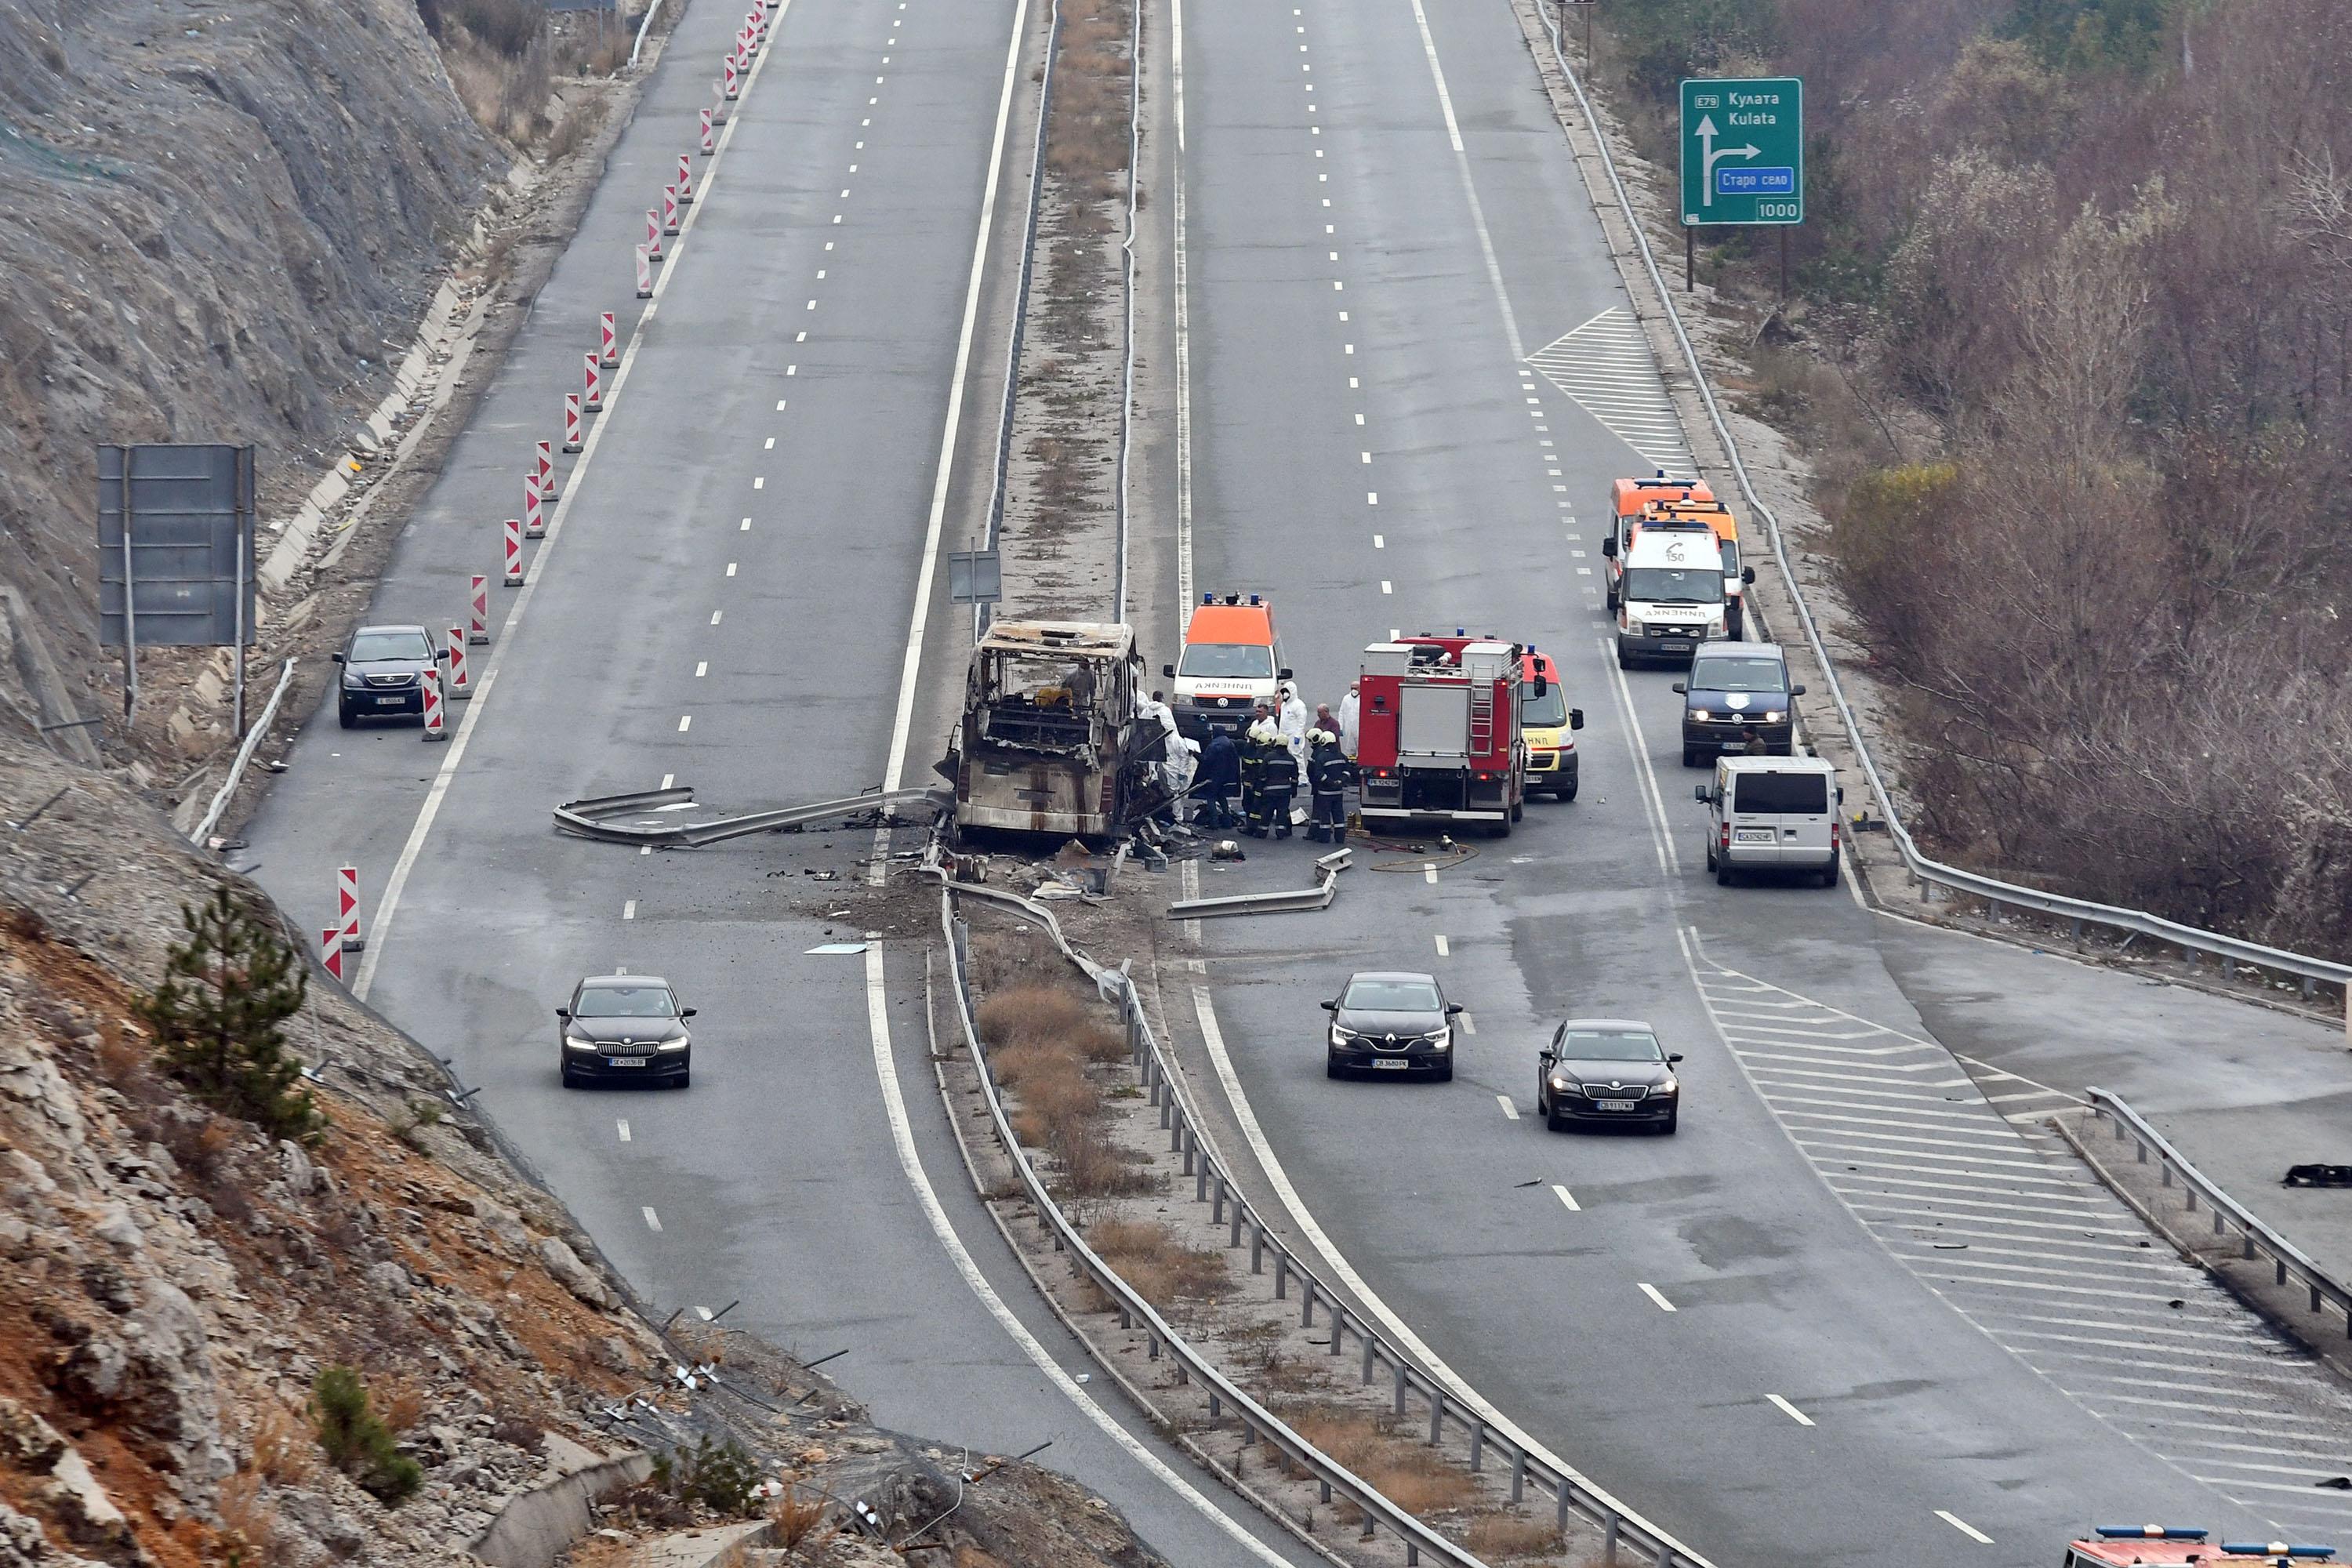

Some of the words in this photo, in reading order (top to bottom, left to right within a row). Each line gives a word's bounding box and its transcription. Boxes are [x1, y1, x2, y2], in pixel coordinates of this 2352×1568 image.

[1697, 97, 1717, 106] E79
[1729, 93, 1780, 107] Кулата
[1729, 112, 1777, 125] Kulata
[1722, 173, 1756, 188] Старо
[1762, 175, 1788, 185] село
[1759, 204, 1797, 217] 1000
[1665, 553, 1685, 562] 150
